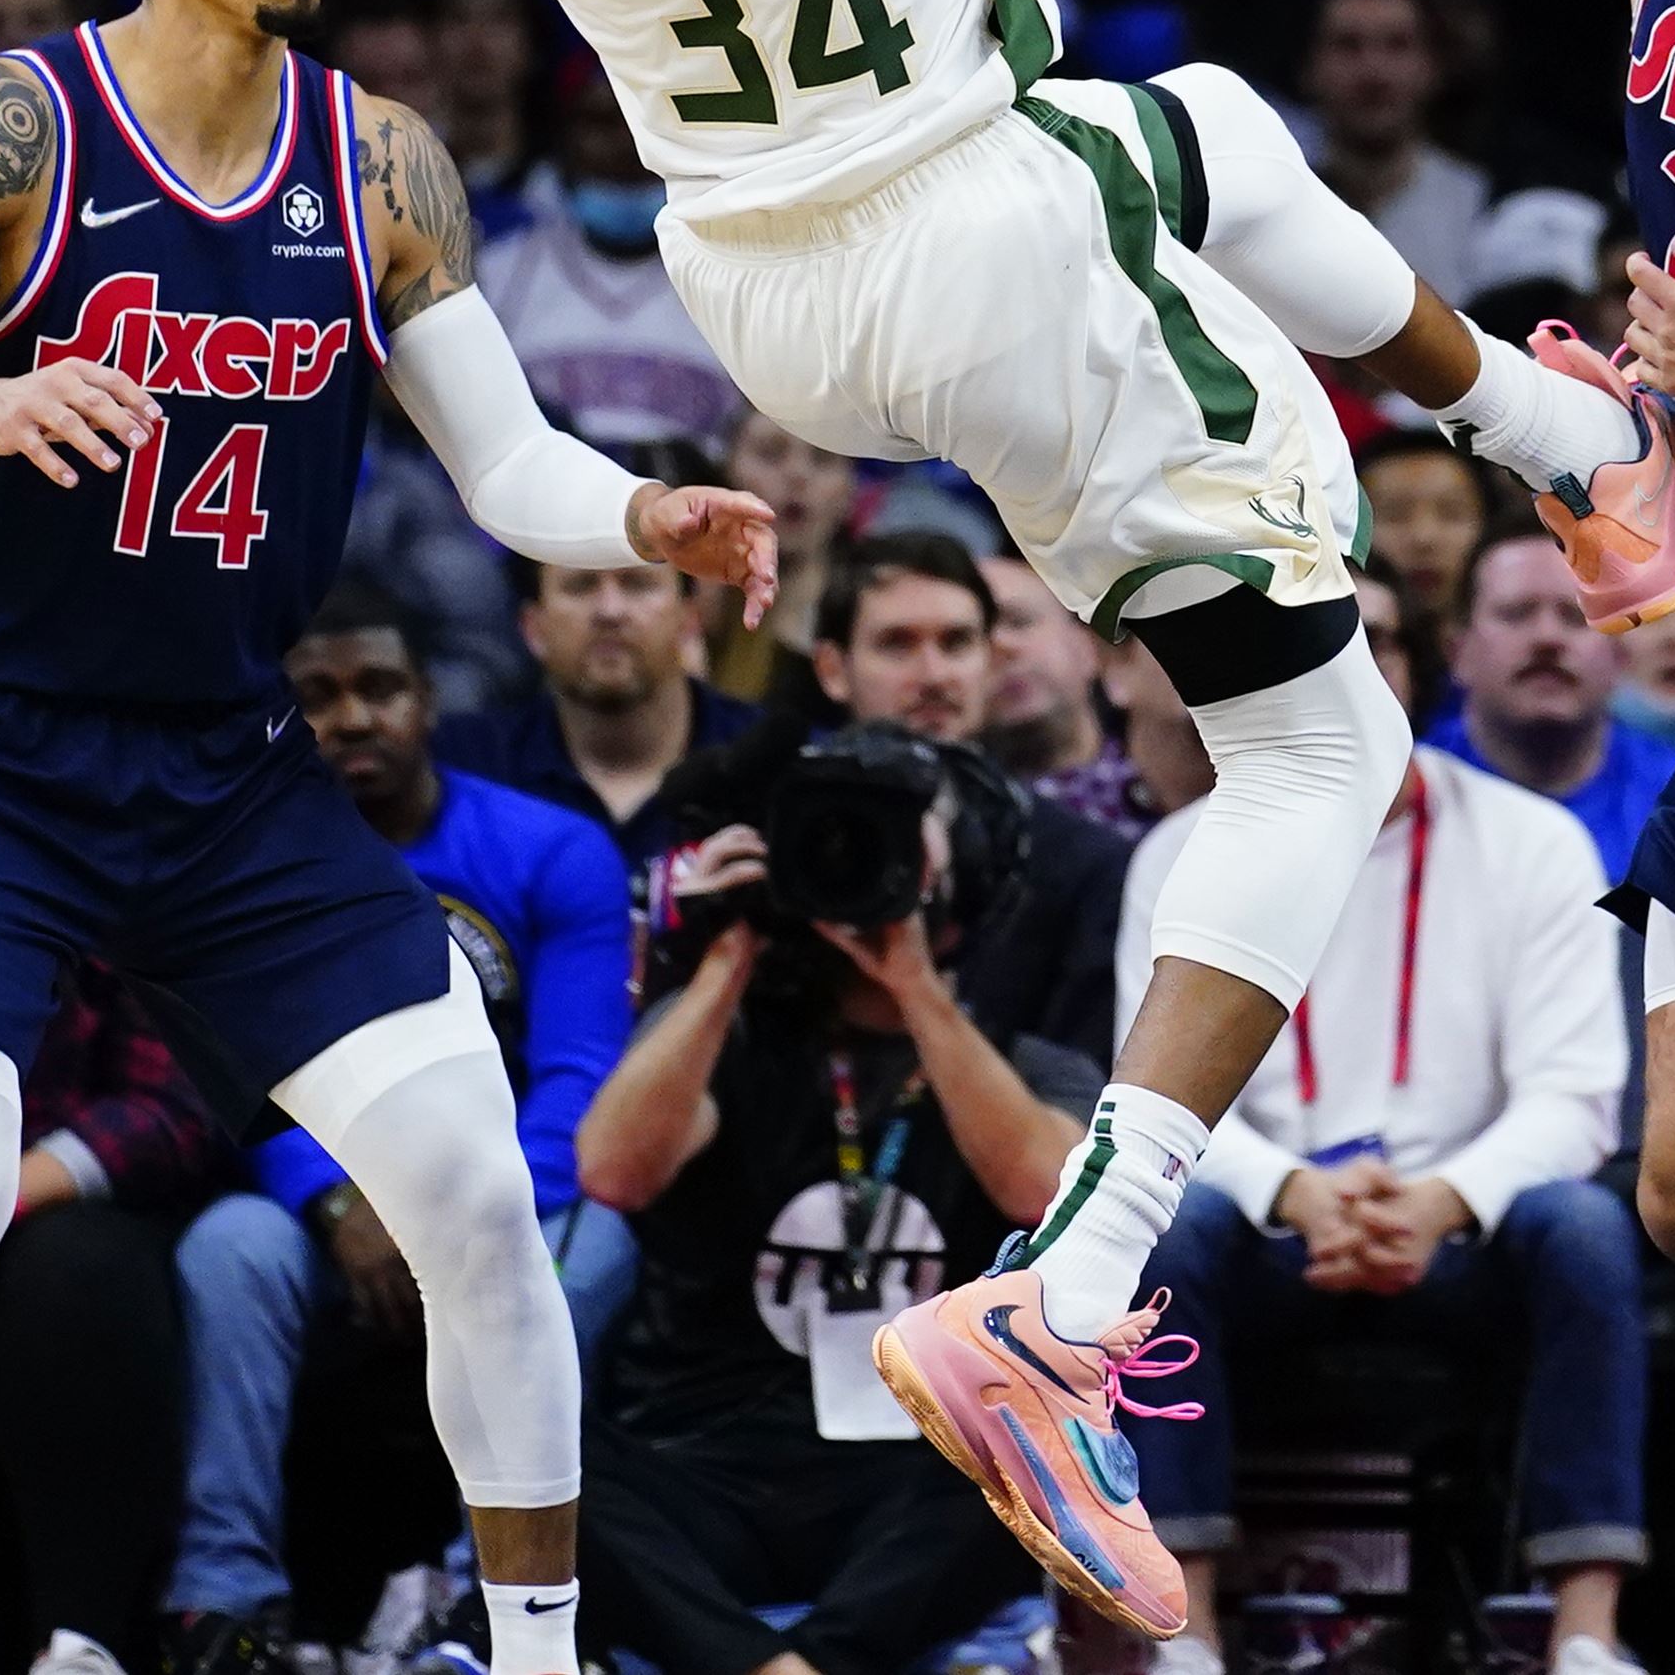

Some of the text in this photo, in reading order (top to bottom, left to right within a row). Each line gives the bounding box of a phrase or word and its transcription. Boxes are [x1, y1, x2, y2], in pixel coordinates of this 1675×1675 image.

[271, 243, 346, 259] crypto.com
[34, 272, 351, 401] Sixers
[114, 416, 269, 570] 14
